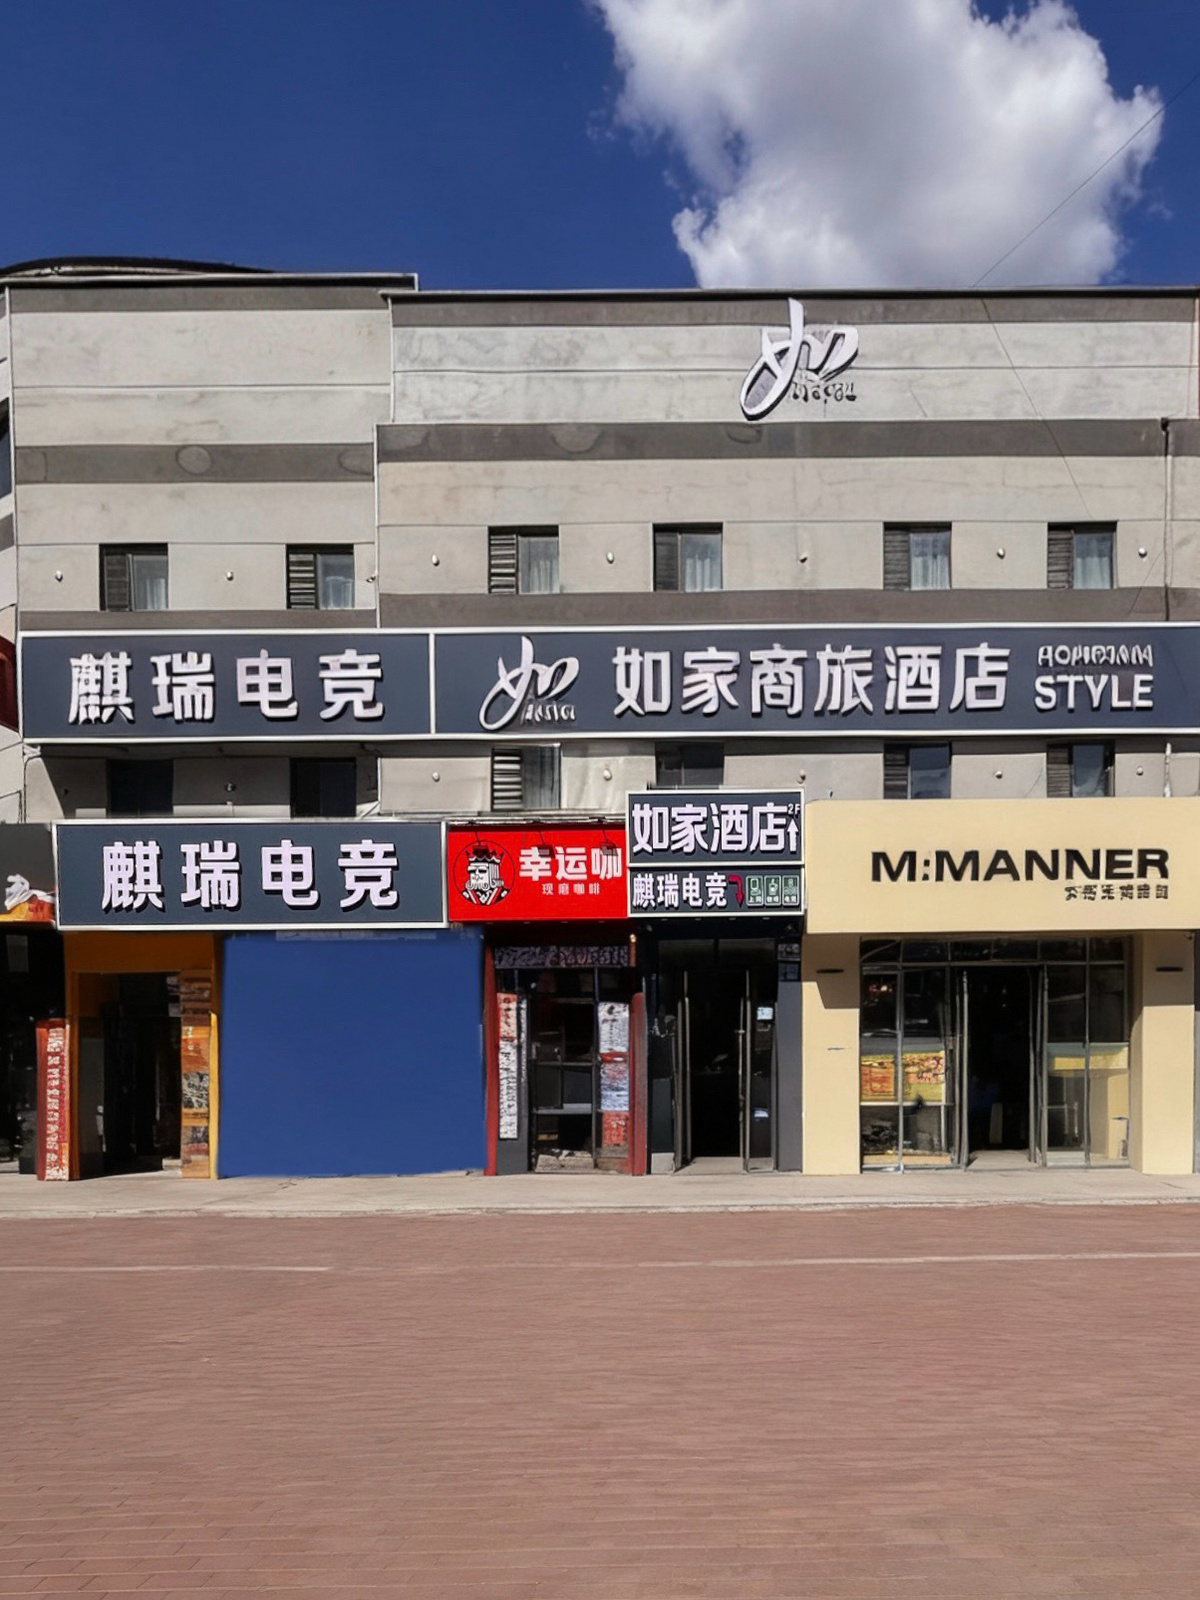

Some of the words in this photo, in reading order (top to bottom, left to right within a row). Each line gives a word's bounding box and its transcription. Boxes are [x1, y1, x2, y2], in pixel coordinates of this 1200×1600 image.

[68, 648, 385, 724] 麒瑞电竞
[611, 642, 1011, 717] 如家商旅酒店
[1034, 673, 1154, 710] STYLE
[632, 802, 788, 854] 如家酒店
[102, 838, 399, 911] 麒瑞电竞
[519, 846, 623, 882] 幸运咖
[632, 872, 728, 908] 麒瑞电竞
